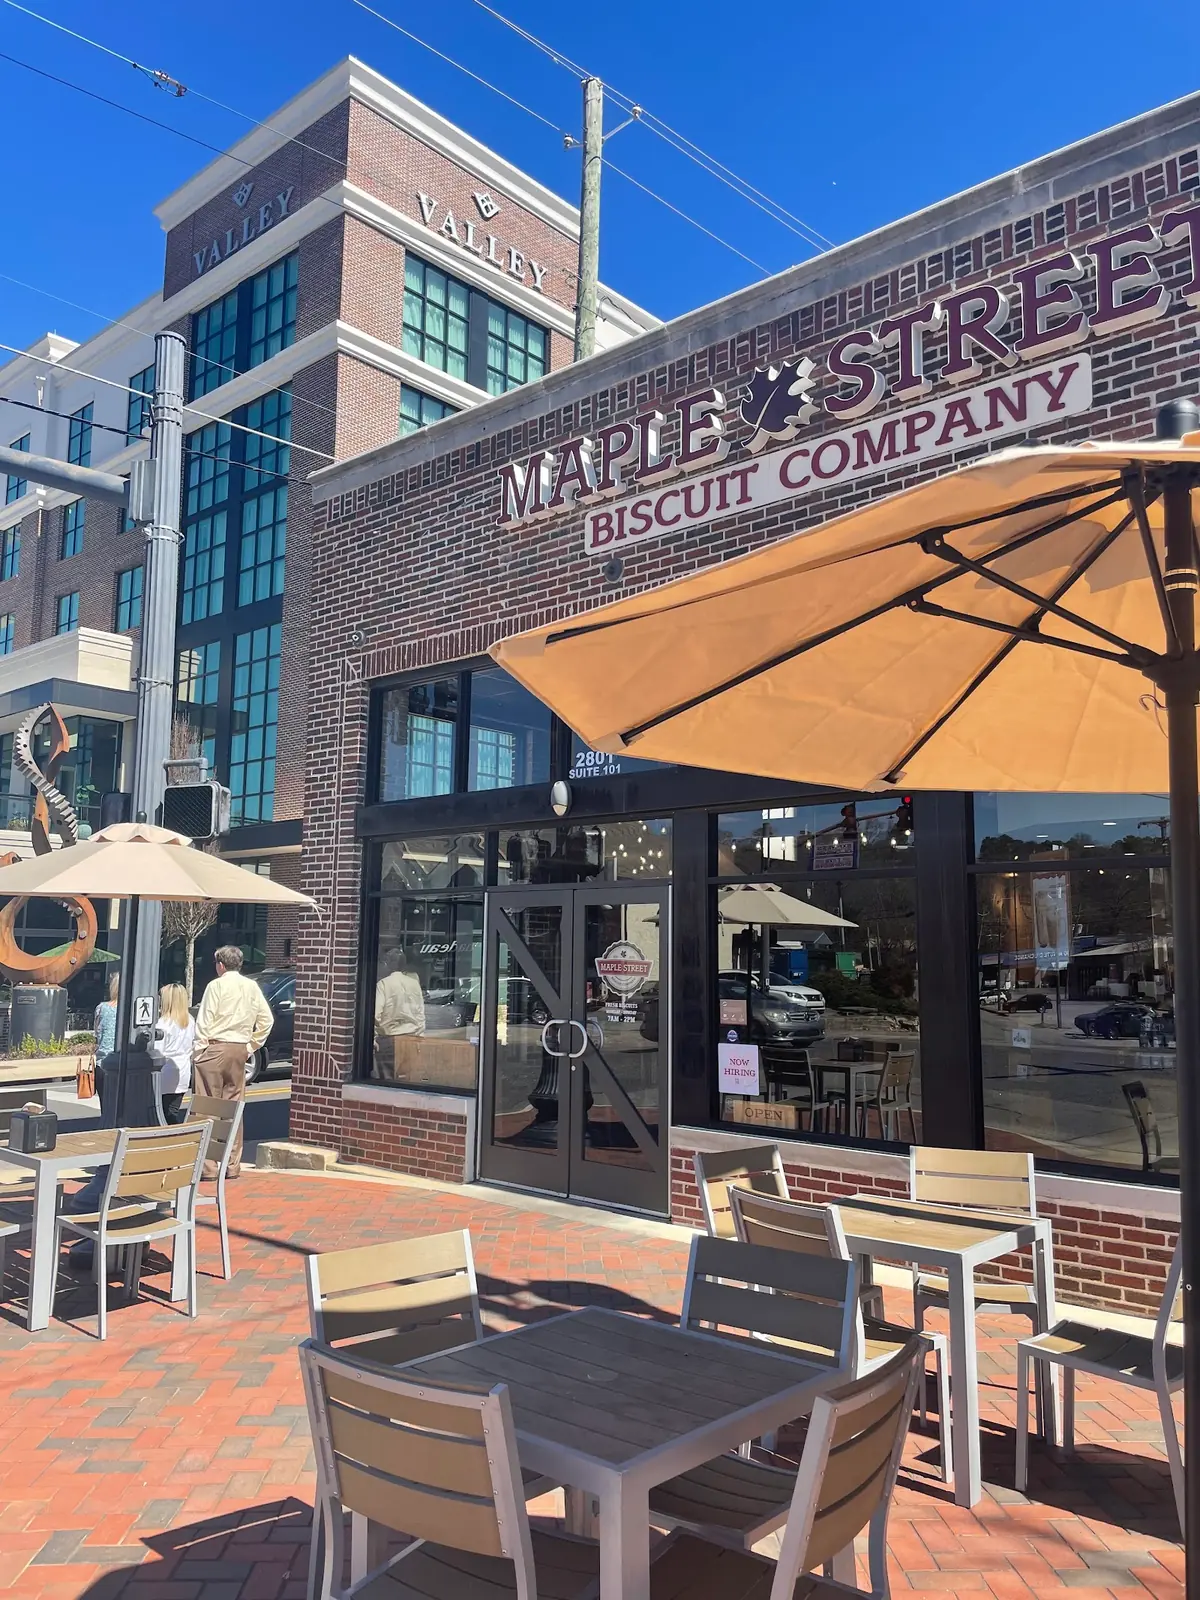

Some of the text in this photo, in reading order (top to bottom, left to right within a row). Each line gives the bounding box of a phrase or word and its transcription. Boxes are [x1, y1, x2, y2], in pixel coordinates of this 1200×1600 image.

[193, 185, 296, 274] VALLEY
[416, 190, 548, 291] VALLEY
[496, 206, 1200, 530] MAPLE STREET
[589, 361, 1080, 549] BISCUIT COMPANY
[575, 751, 613, 767] 2801
[568, 763, 621, 779] SUITE 101
[600, 963, 648, 972] MAPLE STREET
[724, 1068, 756, 1077] HIRING
[744, 1107, 783, 1121] OPEN
